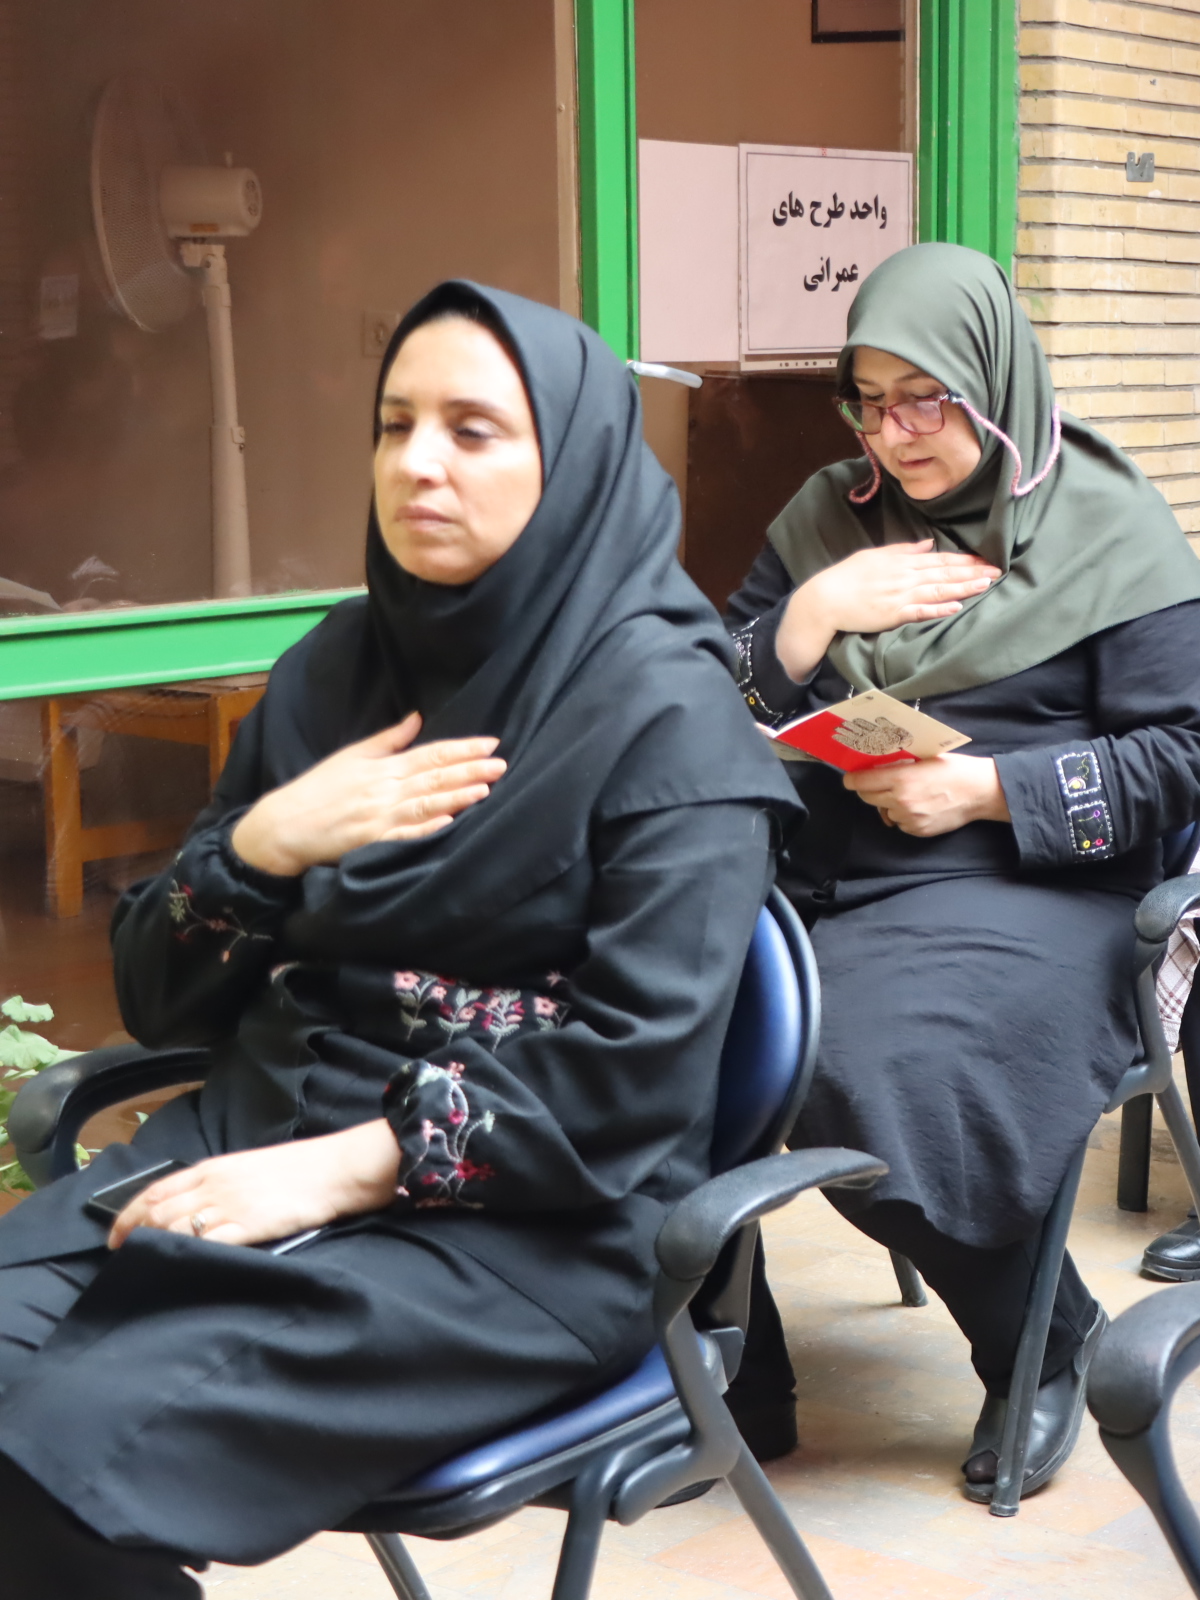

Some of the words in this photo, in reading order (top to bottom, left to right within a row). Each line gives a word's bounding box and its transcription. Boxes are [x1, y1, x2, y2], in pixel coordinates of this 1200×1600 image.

[772, 191, 805, 227] های
[809, 192, 846, 228] طرح
[850, 194, 888, 229] واحد
[803, 256, 859, 292] عمرانی
